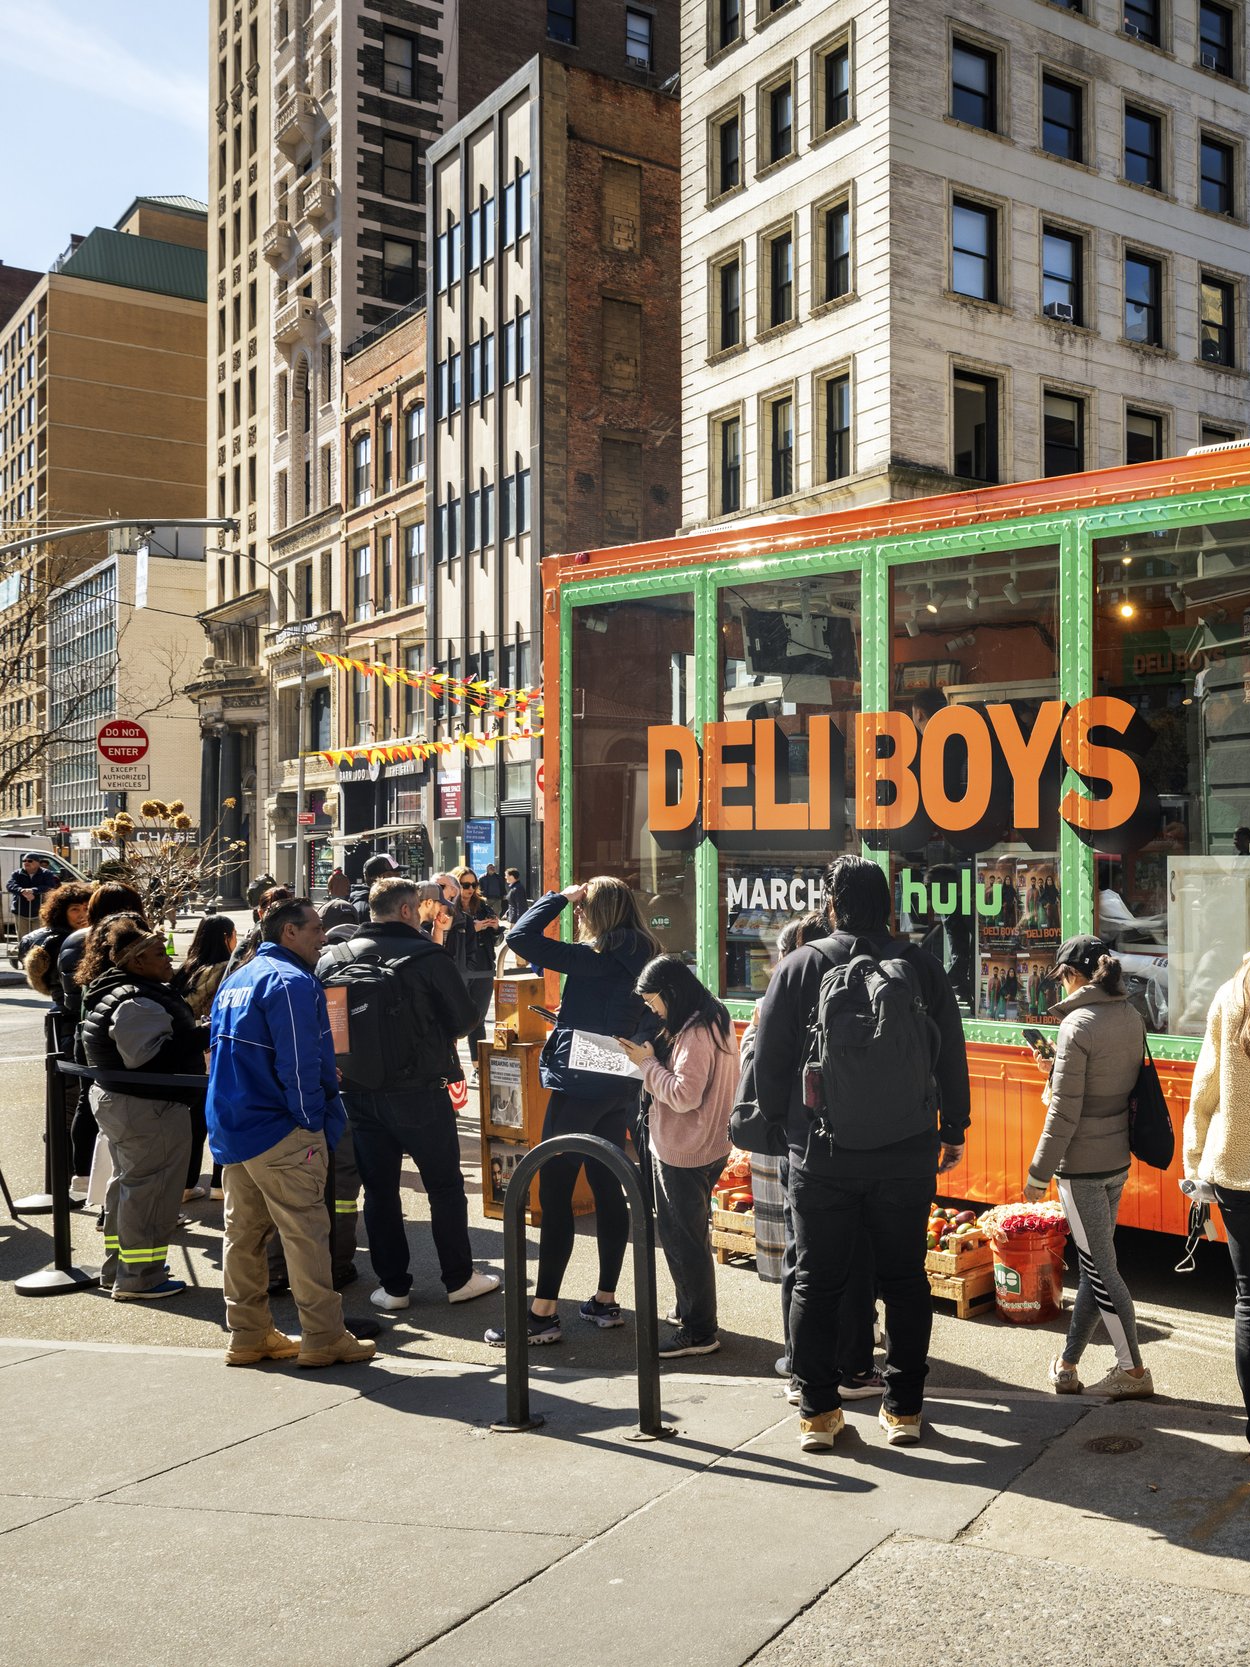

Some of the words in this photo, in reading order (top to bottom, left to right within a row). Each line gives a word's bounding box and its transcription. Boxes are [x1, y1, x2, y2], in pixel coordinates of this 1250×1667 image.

[1133, 650, 1172, 674] DELI
[105, 728, 118, 737] DO
[121, 728, 140, 737] NOT
[108, 748, 139, 756] ENTER
[647, 715, 837, 840] DELI
[855, 696, 1150, 842] BOYS
[136, 831, 196, 843] CHASE
[727, 877, 825, 911] MARCH
[902, 868, 1003, 916] hulu
[983, 927, 1000, 936] DELI
[1000, 927, 1020, 936] BOYS
[1026, 929, 1043, 939] DELI
[1026, 1015, 1043, 1024] DELI
